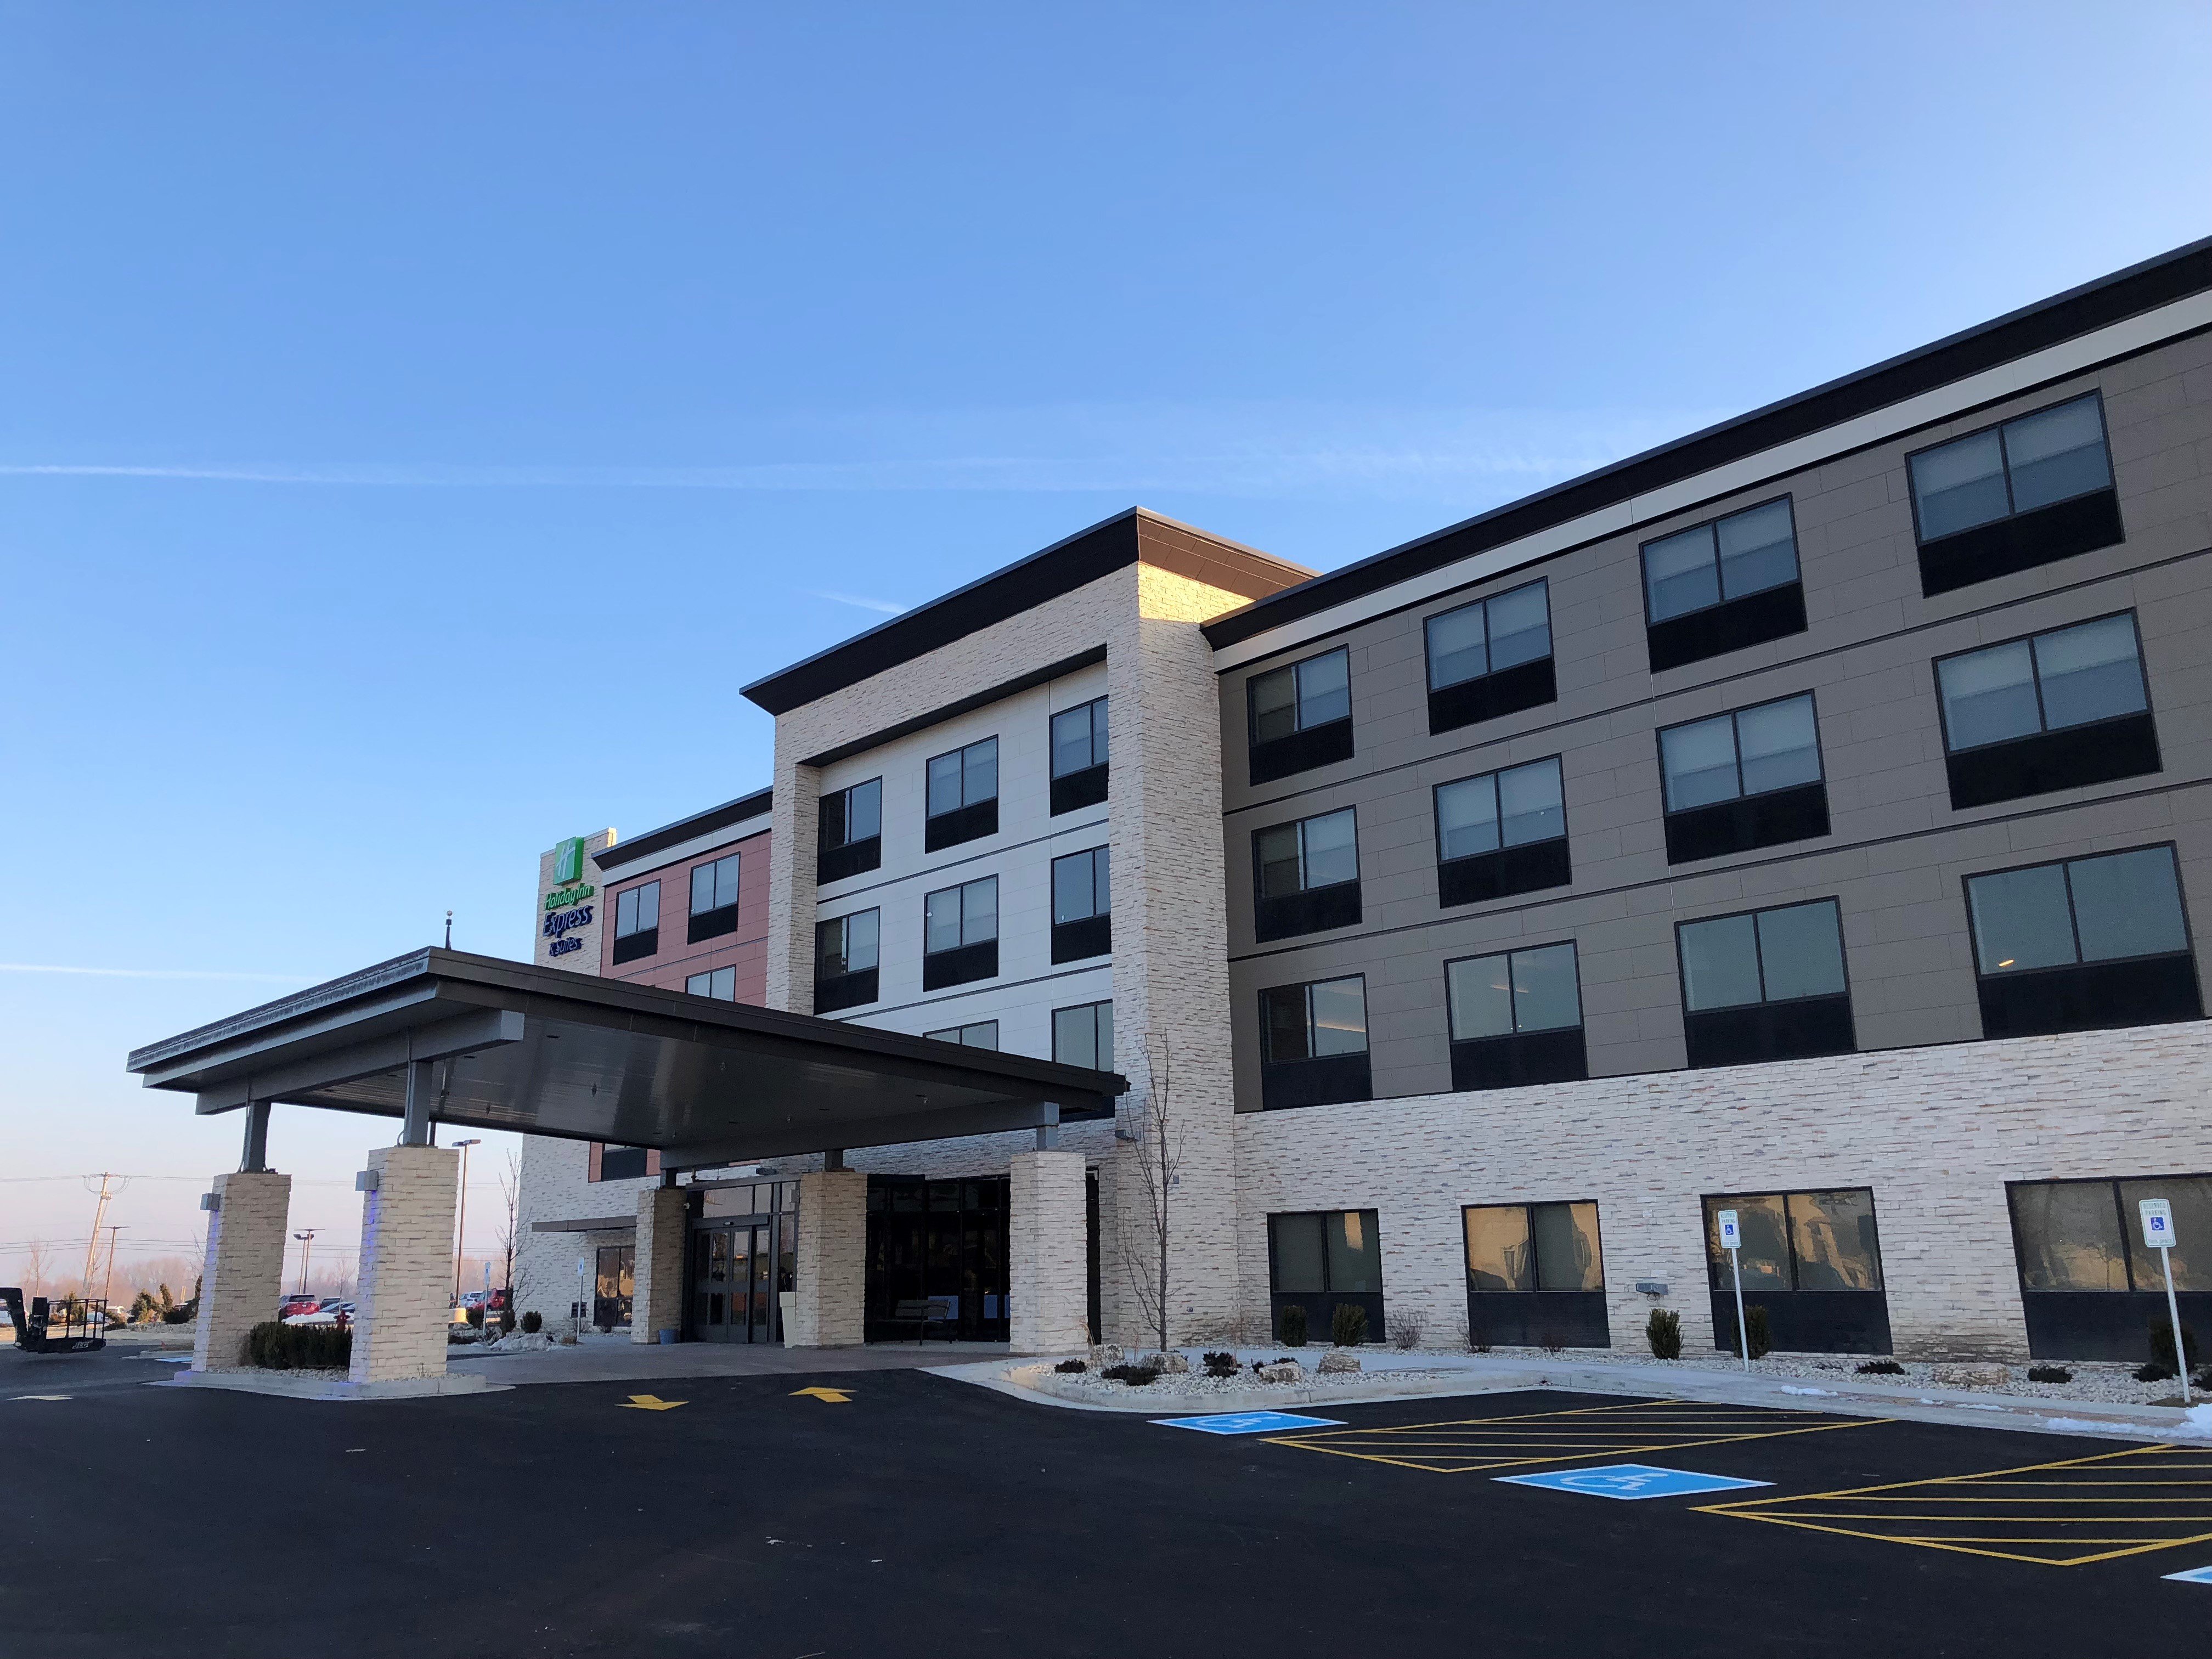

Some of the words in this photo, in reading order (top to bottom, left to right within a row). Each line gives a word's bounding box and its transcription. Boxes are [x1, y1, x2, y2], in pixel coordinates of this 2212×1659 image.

[545, 887, 577, 910] Holiday
[576, 883, 592, 900] Inn
[543, 905, 591, 938] Express
[555, 937, 582, 955] Suites
